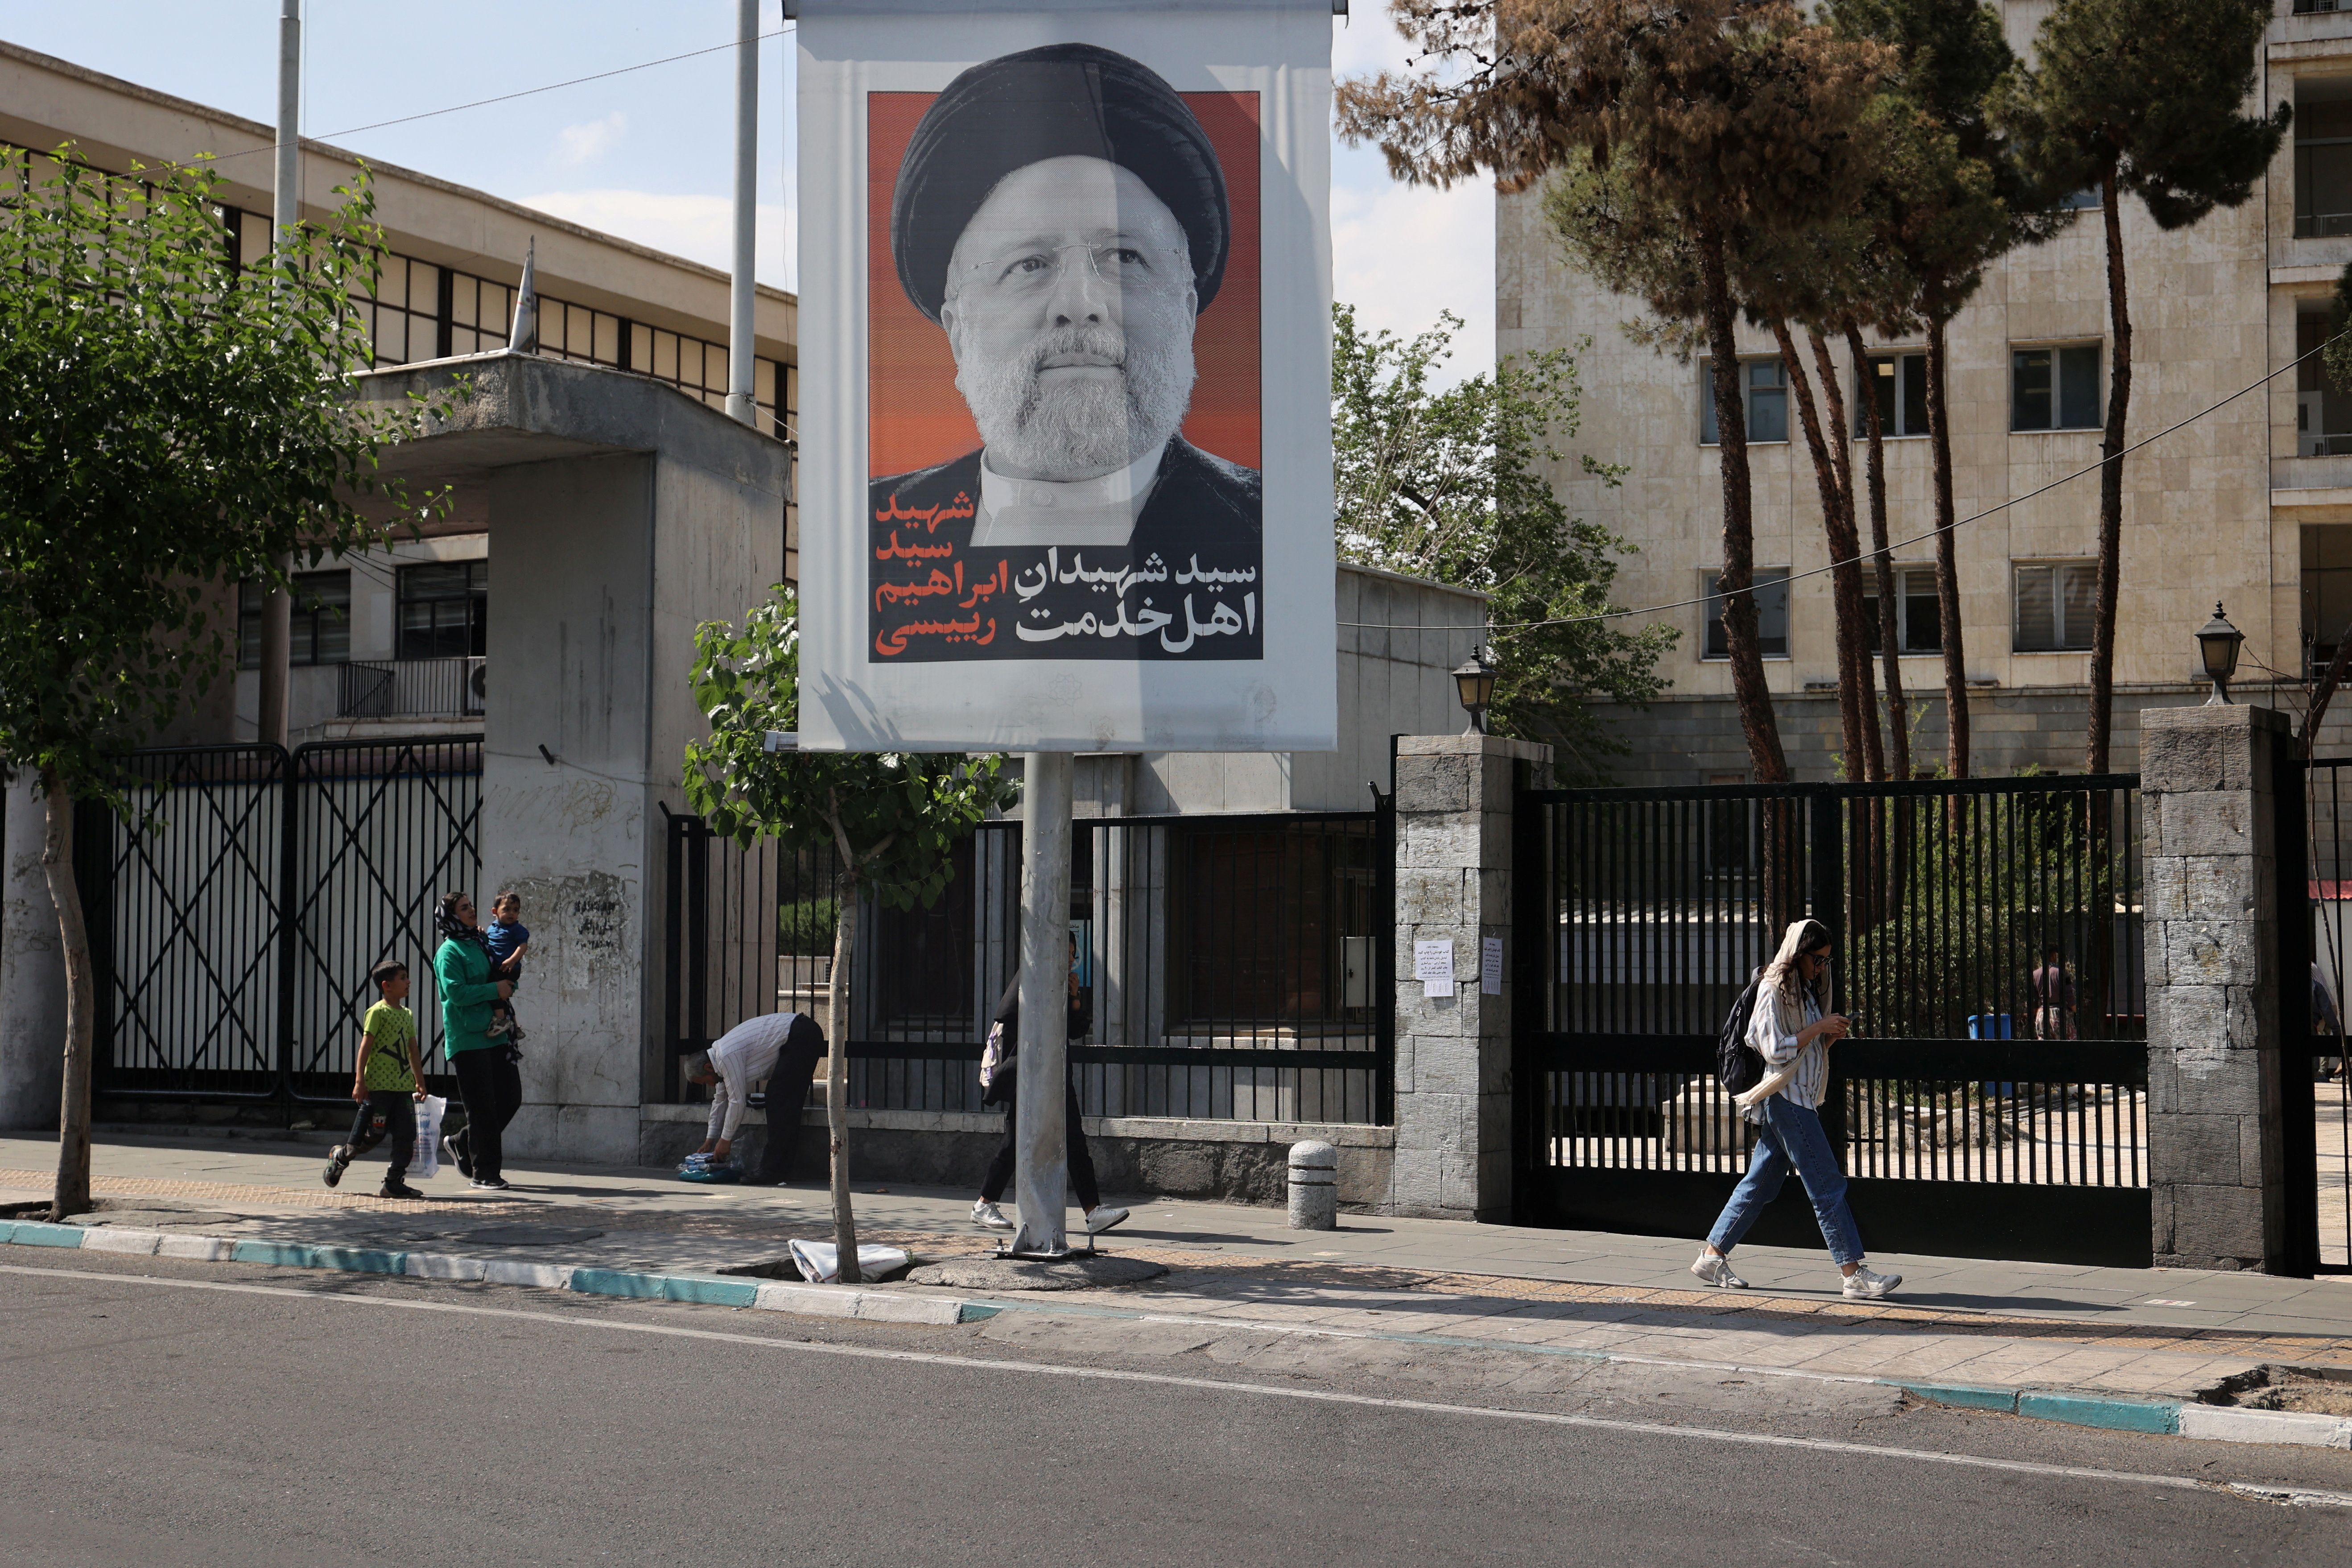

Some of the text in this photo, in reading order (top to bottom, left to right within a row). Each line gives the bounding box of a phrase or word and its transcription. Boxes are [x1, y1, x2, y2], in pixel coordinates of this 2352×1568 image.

[875, 491, 974, 533] شهید
[876, 531, 953, 567] سید
[875, 560, 1008, 611] ابراهیم
[1175, 553, 1256, 593] سید
[1015, 592, 1255, 653] اهل خدمت
